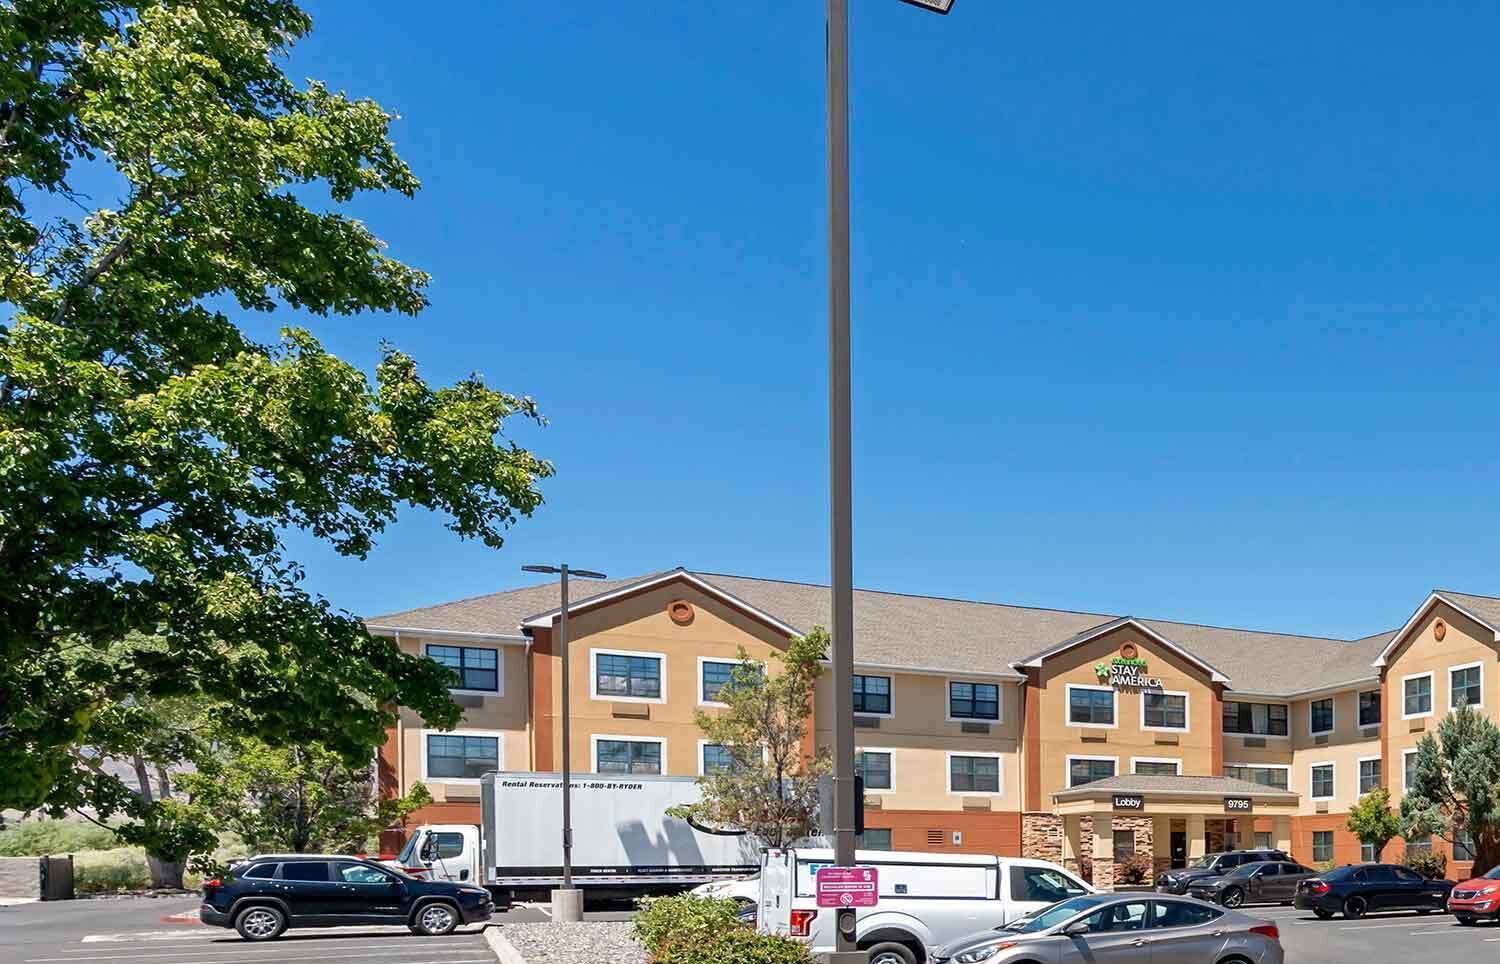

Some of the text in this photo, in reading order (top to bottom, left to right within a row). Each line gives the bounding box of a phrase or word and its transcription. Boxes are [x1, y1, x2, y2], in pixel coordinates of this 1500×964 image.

[1111, 665, 1138, 676] STAY
[1111, 675, 1163, 687] AMERICA
[1115, 797, 1141, 808] Lobby
[1228, 800, 1249, 809] 9795
